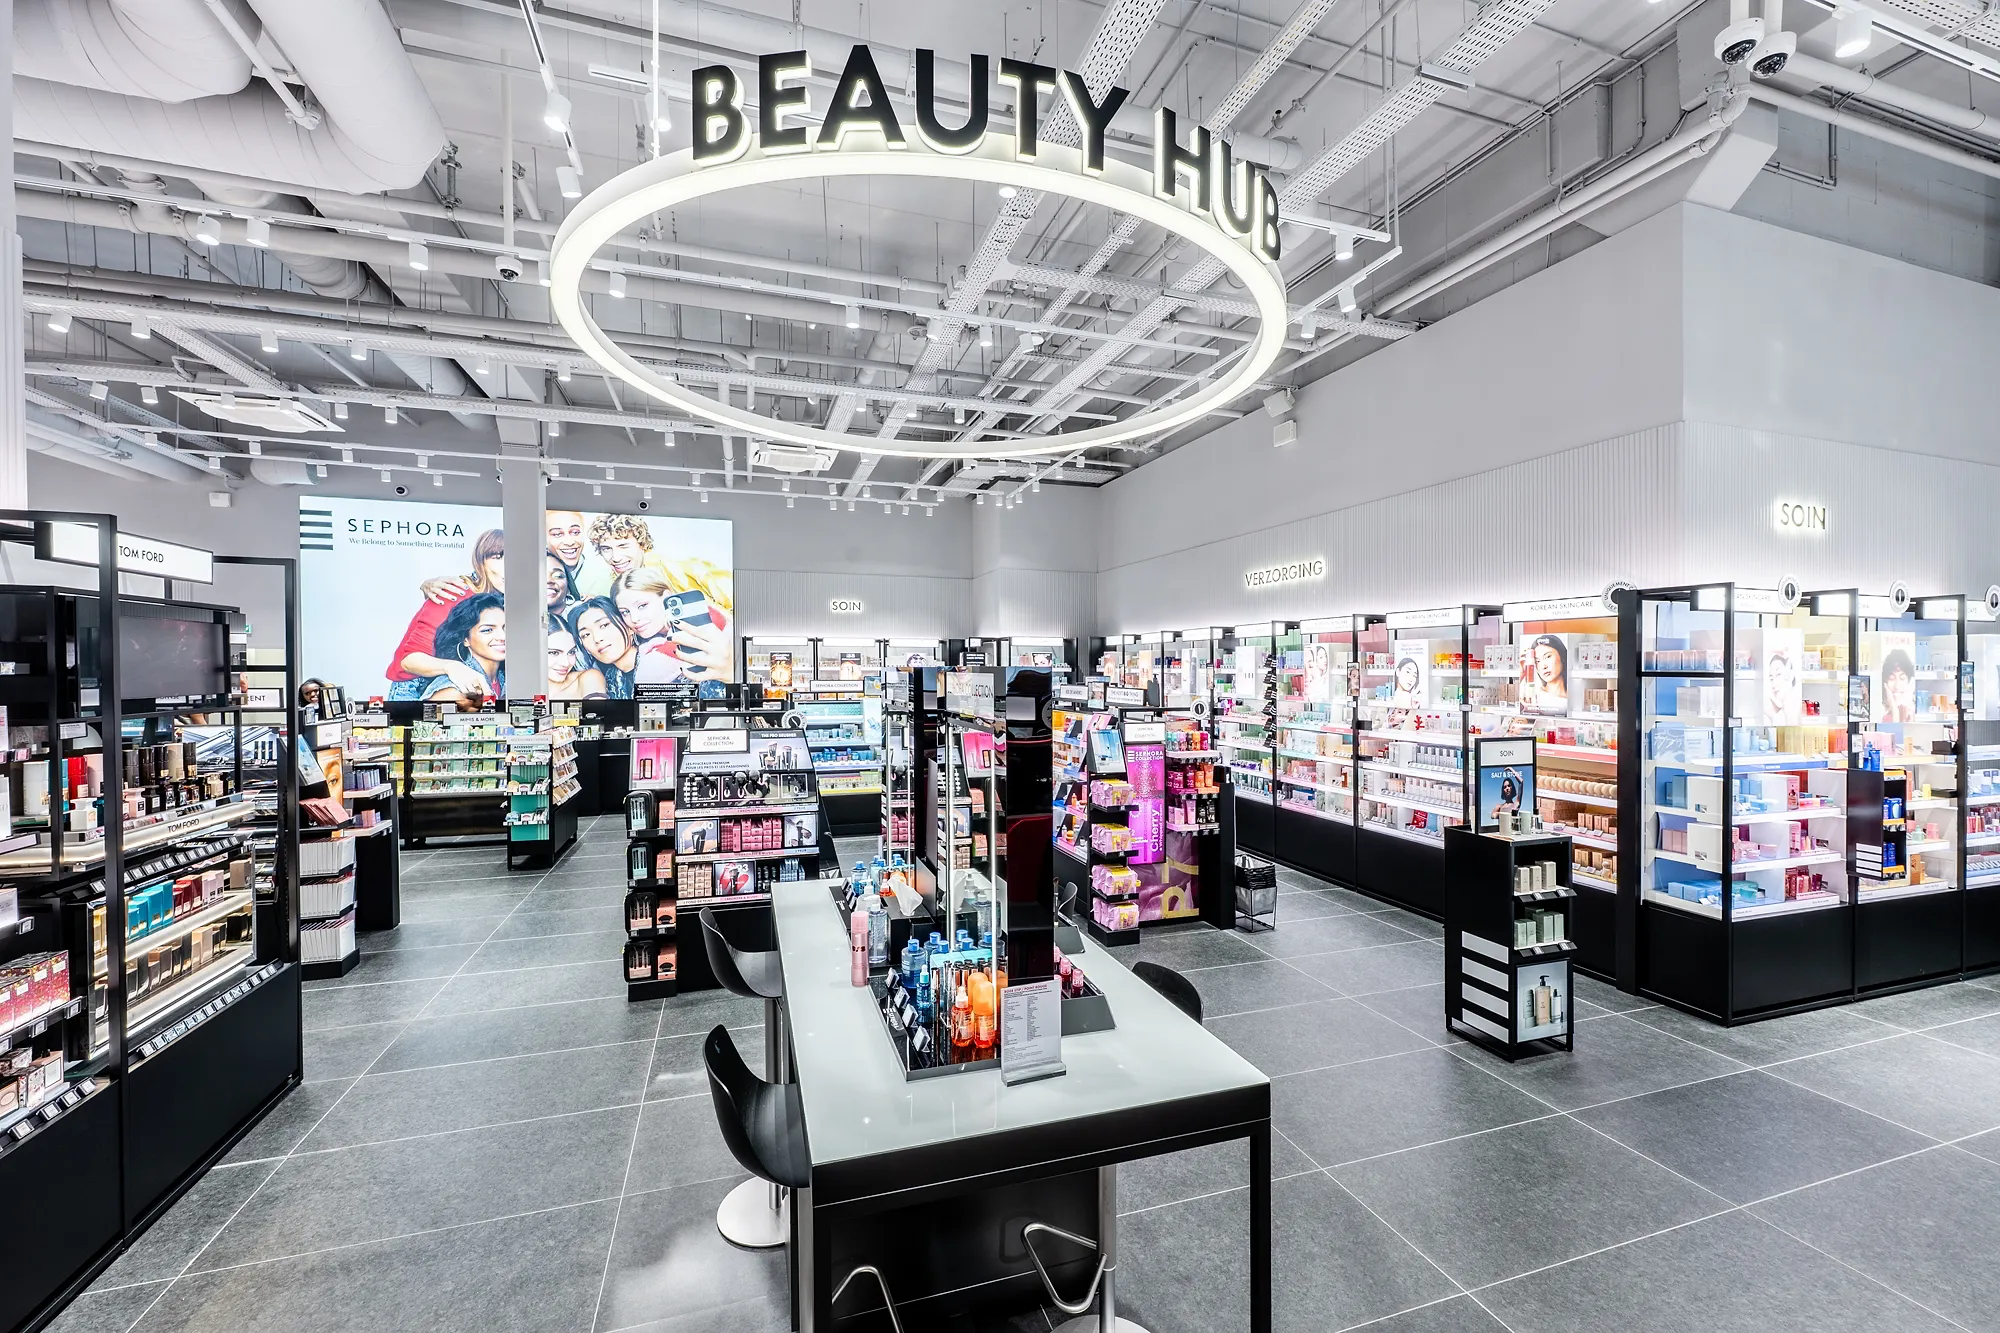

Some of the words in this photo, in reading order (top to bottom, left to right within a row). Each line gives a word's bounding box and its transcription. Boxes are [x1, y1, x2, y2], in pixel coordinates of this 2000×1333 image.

[692, 44, 1129, 177] BEAUTY
[1154, 105, 1282, 263] HUB
[1780, 502, 1826, 530] SOIN
[347, 518, 465, 537] SEPHORA
[362, 538, 387, 546] Belong
[396, 540, 434, 548] Something
[434, 541, 465, 549] Beautiful
[118, 545, 140, 559] TOM
[141, 550, 165, 563] FORD
[1245, 560, 1323, 587] VERZORGING
[831, 600, 861, 611] SOIN
[1559, 601, 1594, 609] SKINCARE
[167, 822, 182, 833] TOM
[182, 818, 200, 829] FORD
[1150, 809, 1160, 852] Cherry
